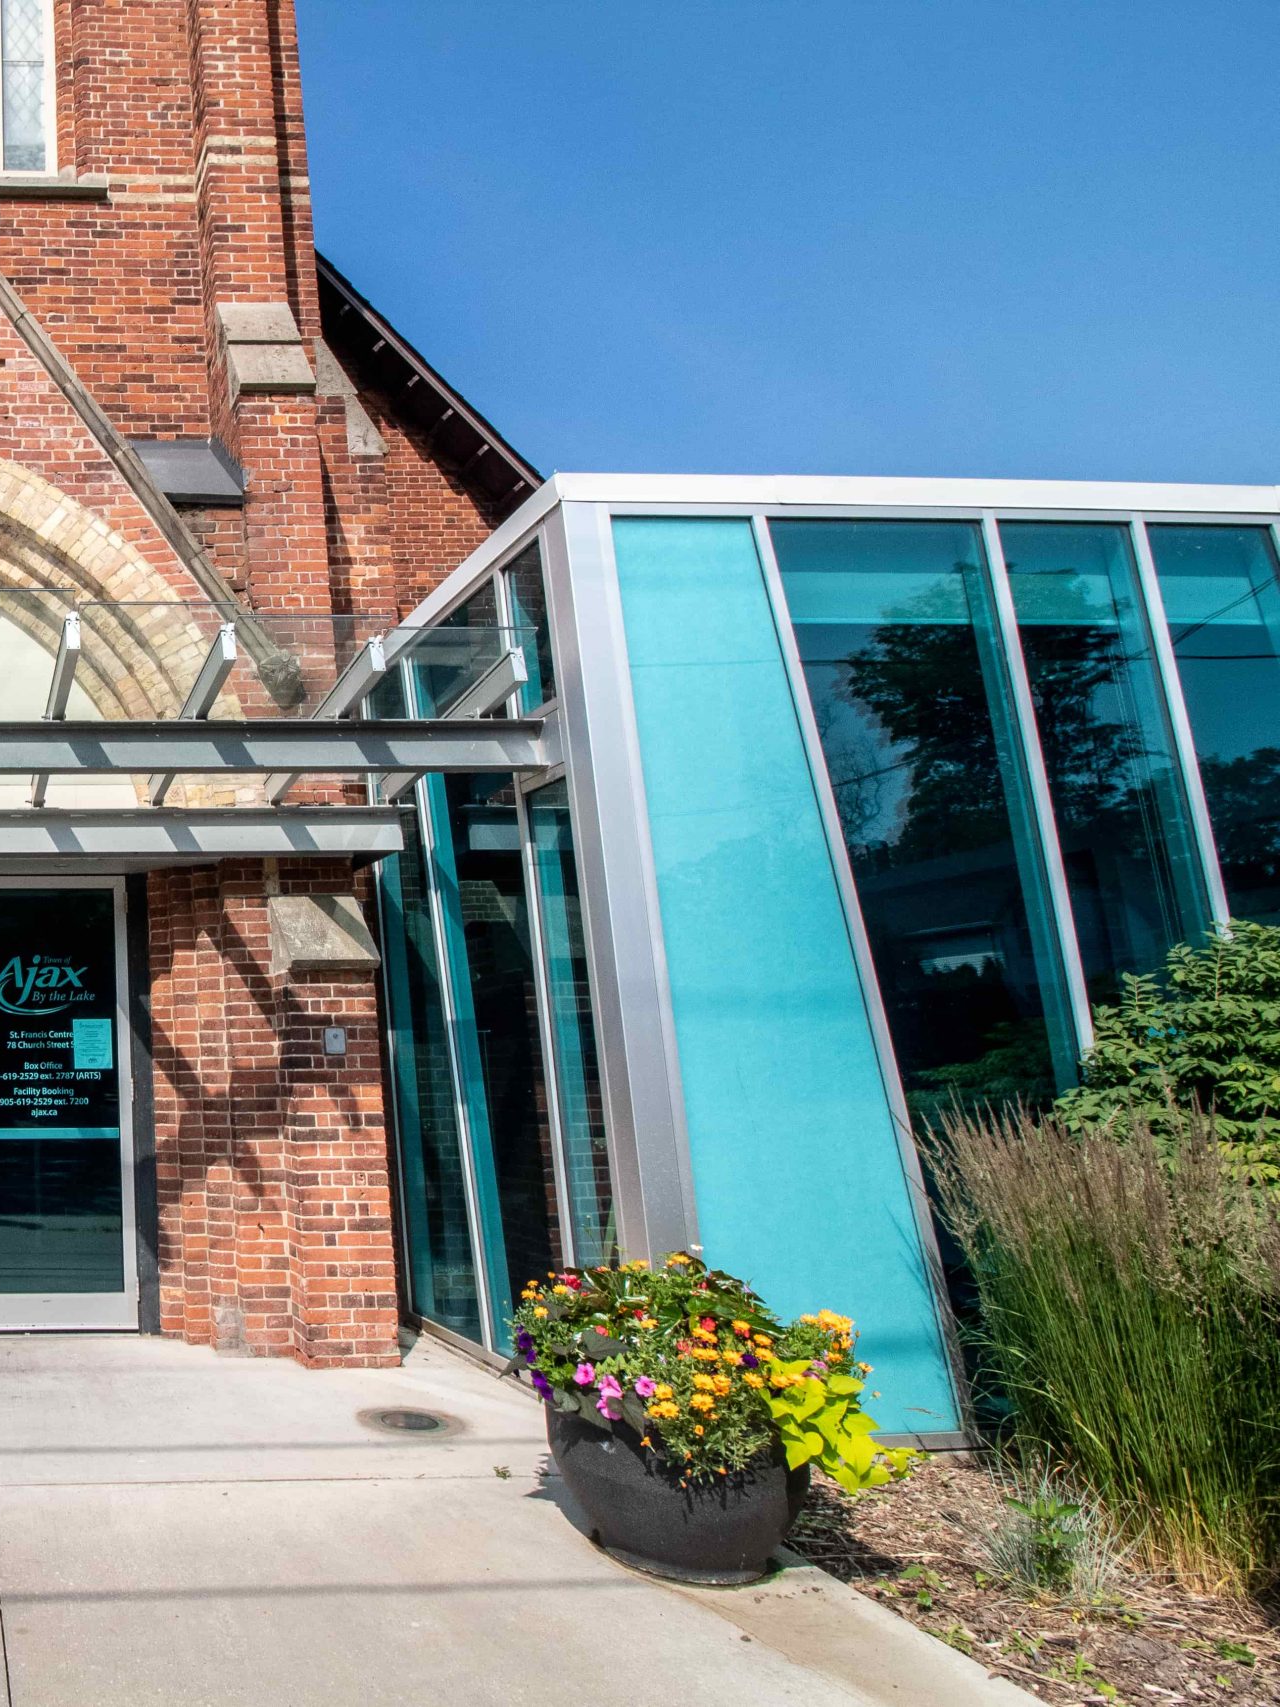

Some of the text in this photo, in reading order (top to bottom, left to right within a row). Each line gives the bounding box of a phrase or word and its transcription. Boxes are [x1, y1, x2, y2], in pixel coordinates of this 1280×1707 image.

[32, 990, 95, 1004] By the Lake
[9, 1030, 74, 1039] St. Francis Centre
[6, 1041, 17, 1049] 78
[17, 1041, 45, 1049] Church
[46, 1041, 70, 1049] Street
[24, 1061, 63, 1070] Box Office
[40, 1072, 55, 1080] ext.
[56, 1072, 75, 1080] 2787
[76, 1071, 102, 1081] (ARTS)
[13, 1087, 75, 1097] Facility Booking
[0, 1097, 89, 1106] 905-619-2529 ext. 7200
[31, 1108, 58, 1118] ajax.ca
